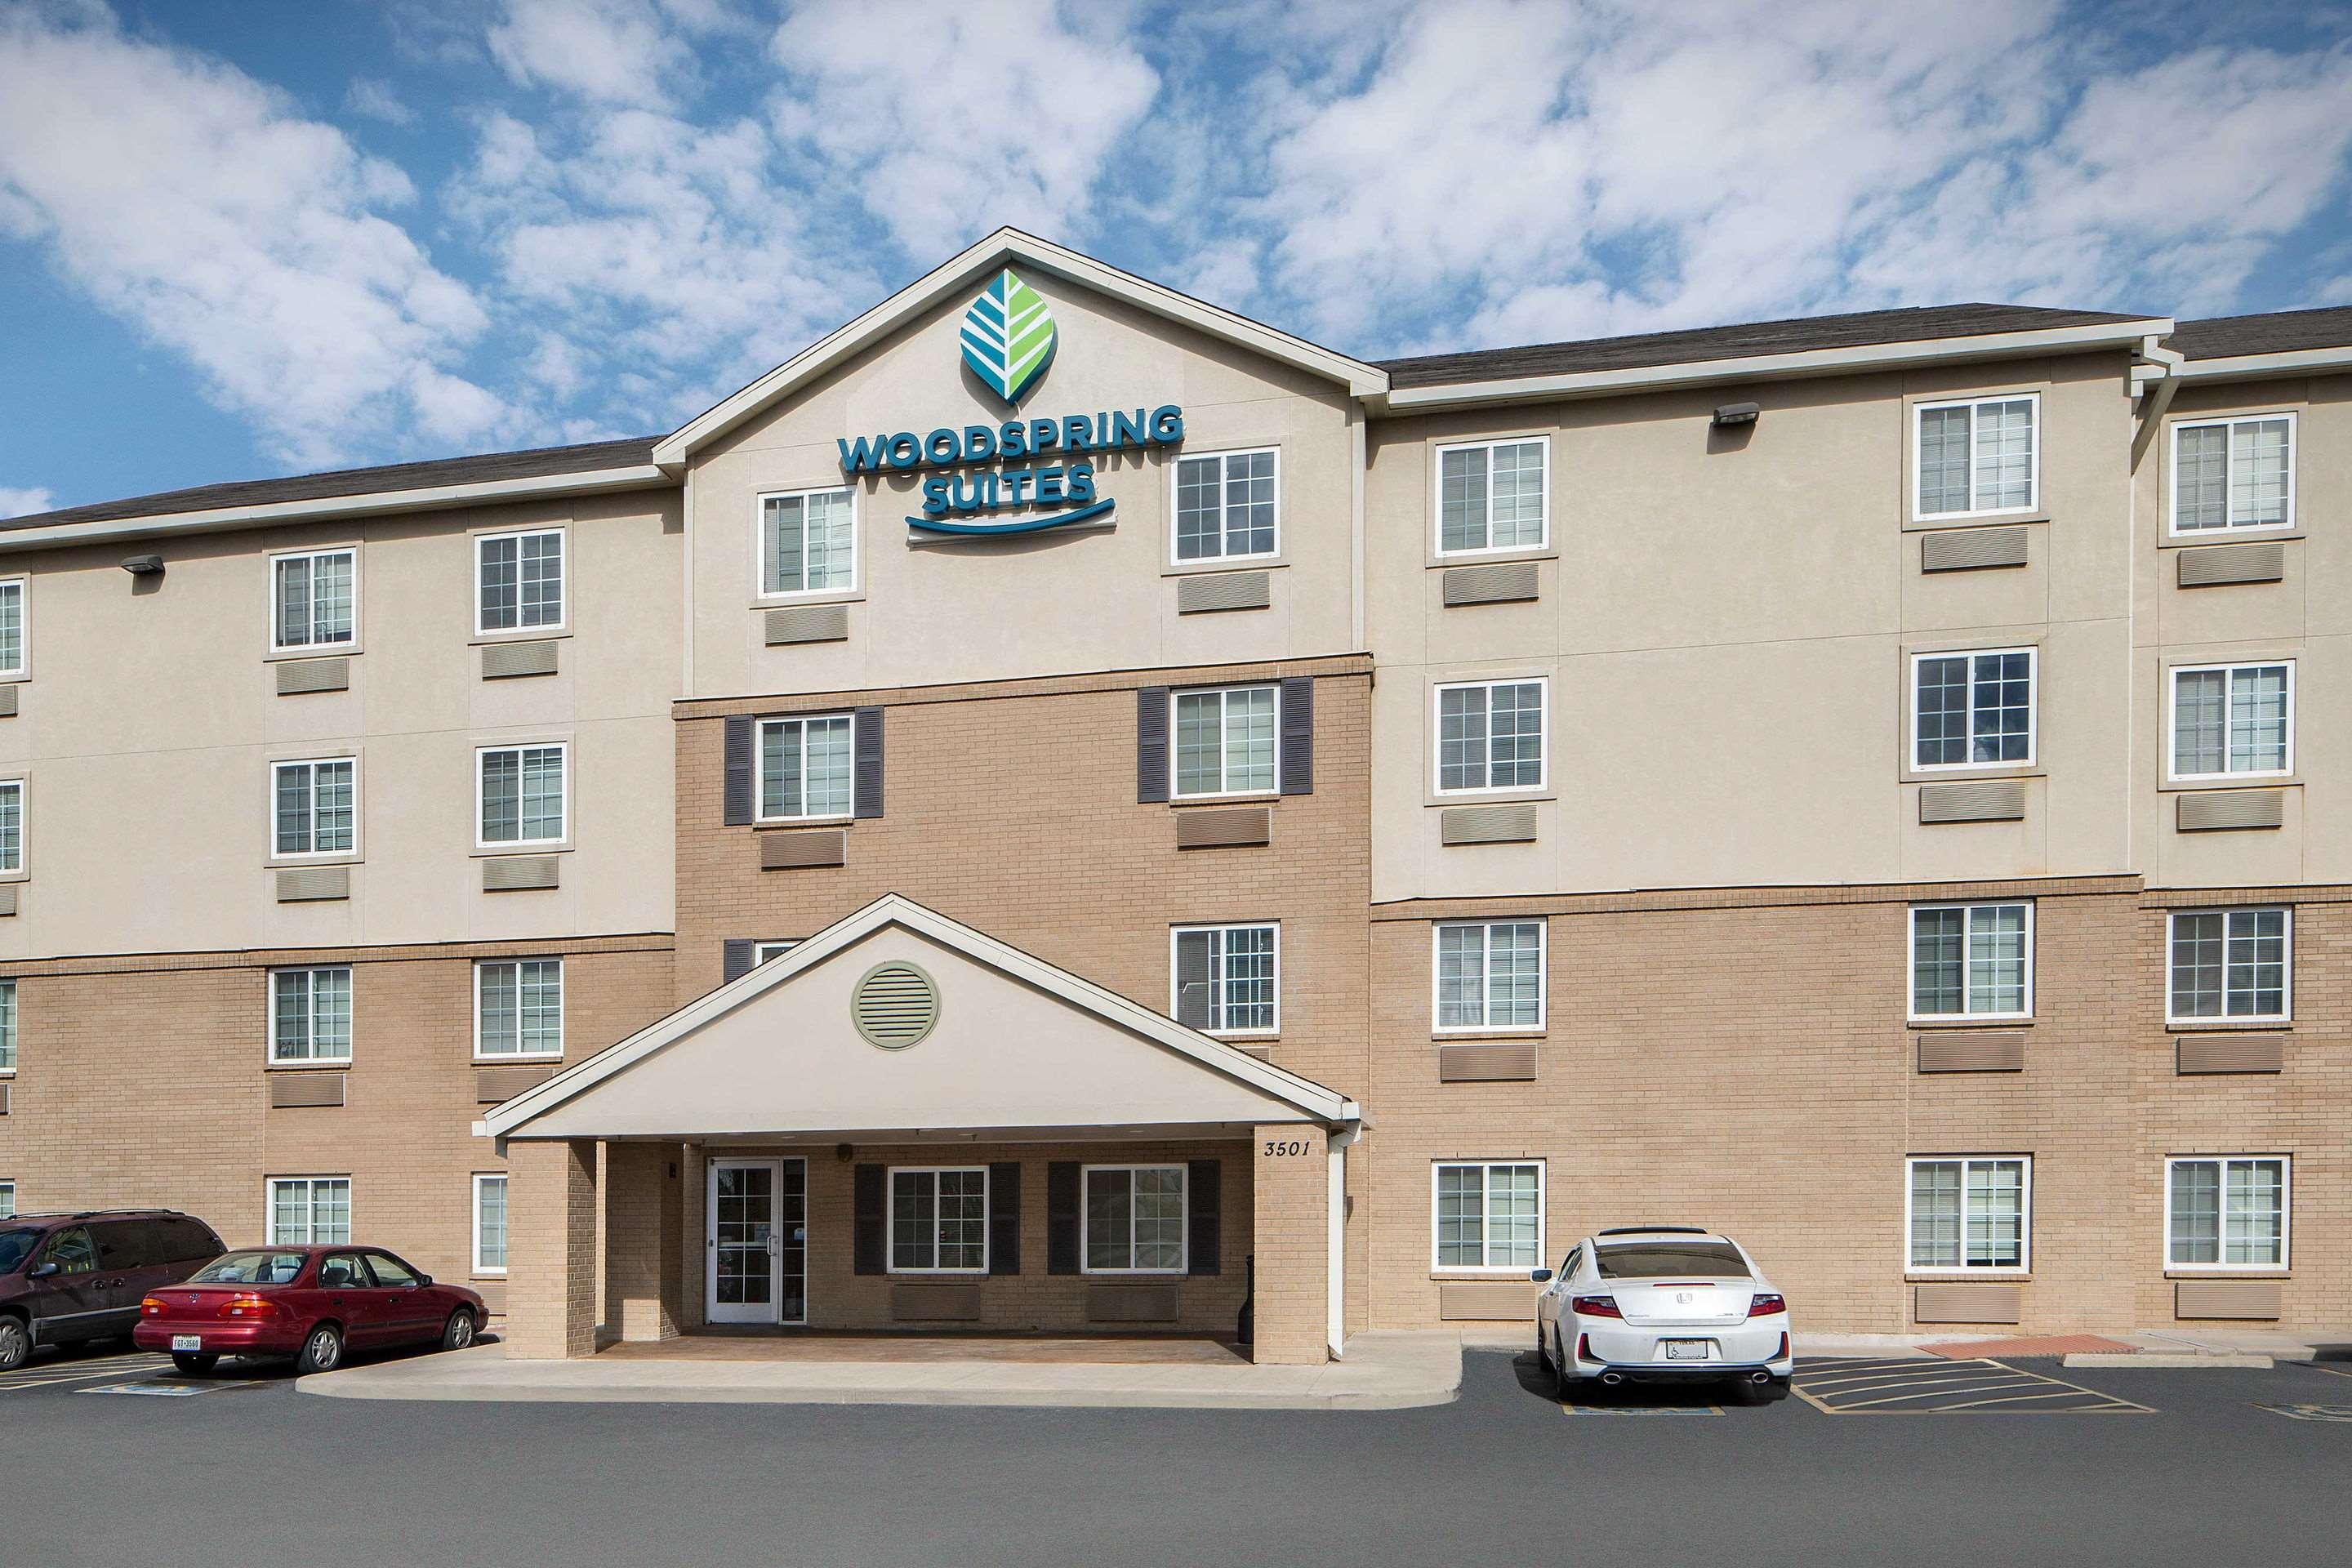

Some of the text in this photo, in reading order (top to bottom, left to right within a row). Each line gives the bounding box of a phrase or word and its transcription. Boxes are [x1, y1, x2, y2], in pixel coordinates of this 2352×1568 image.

[836, 404, 1185, 474] WOODSPRING
[921, 464, 1096, 515] SUITES
[1264, 1141, 1310, 1156] 3501
